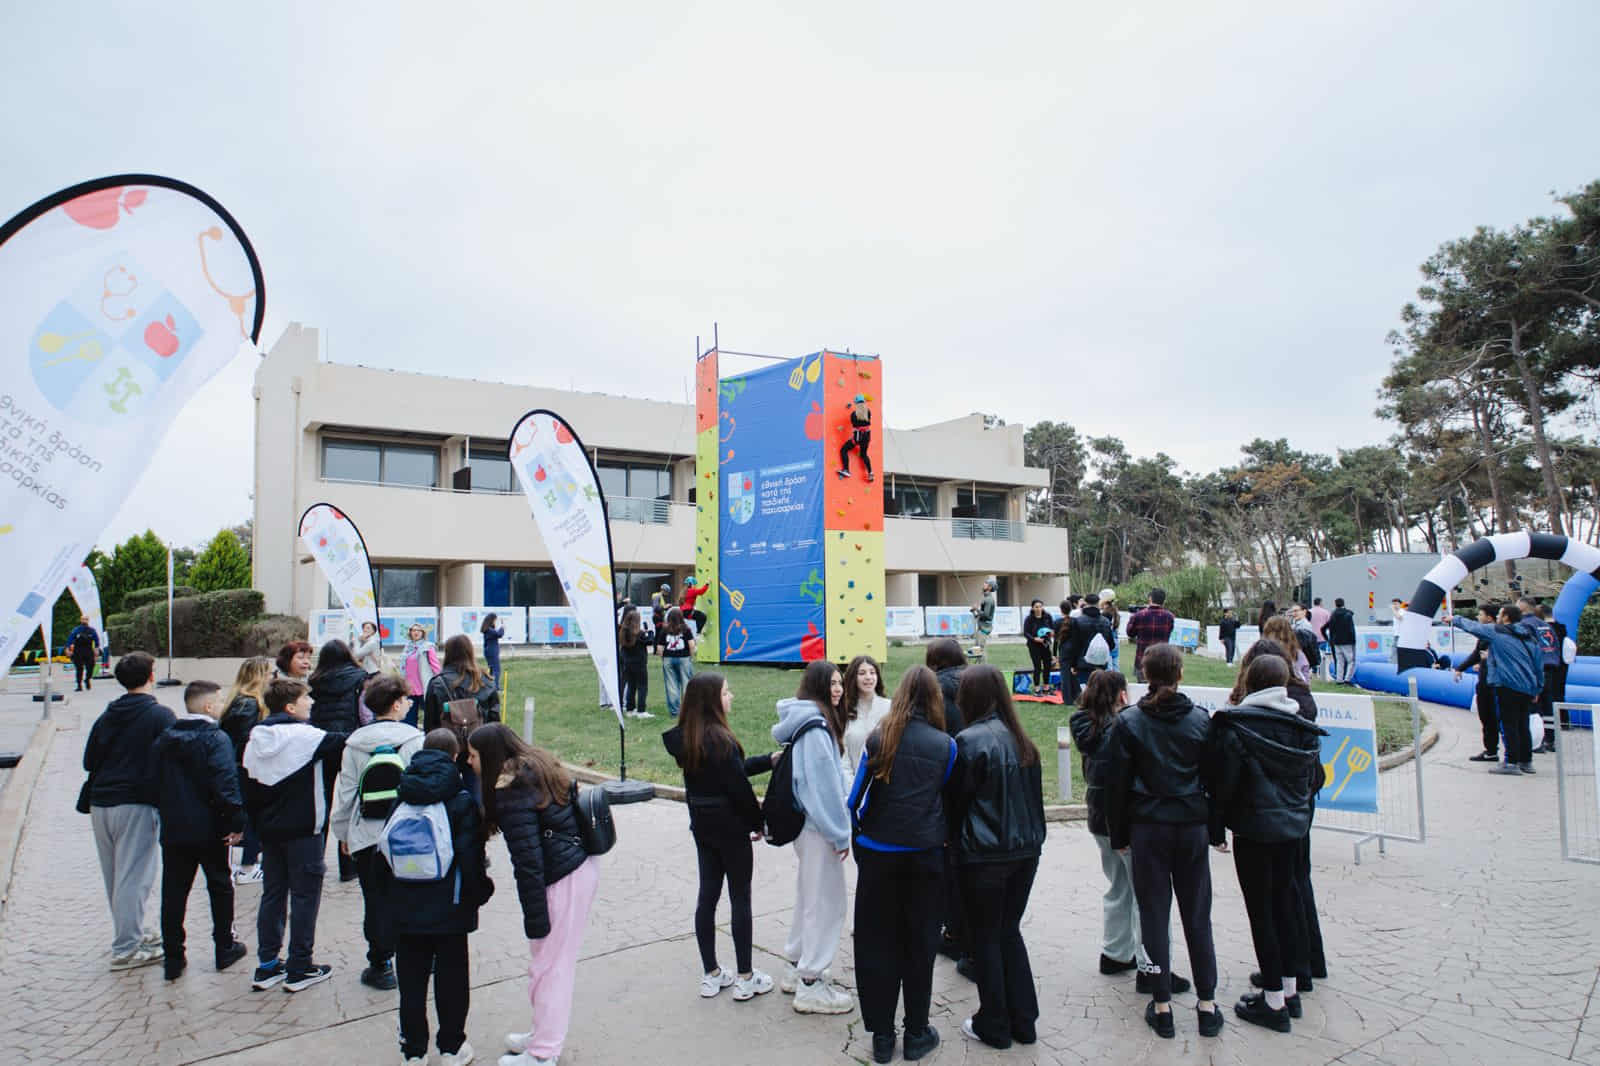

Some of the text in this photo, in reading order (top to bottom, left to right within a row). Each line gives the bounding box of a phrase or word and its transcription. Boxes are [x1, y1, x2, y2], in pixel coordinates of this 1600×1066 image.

[0, 395, 103, 473] θνική δράση
[0, 418, 55, 463] τά της
[0, 436, 41, 473] δικής
[0, 460, 68, 510] σαρκίας
[1319, 707, 1358, 721] ΠΙΔΑ.
